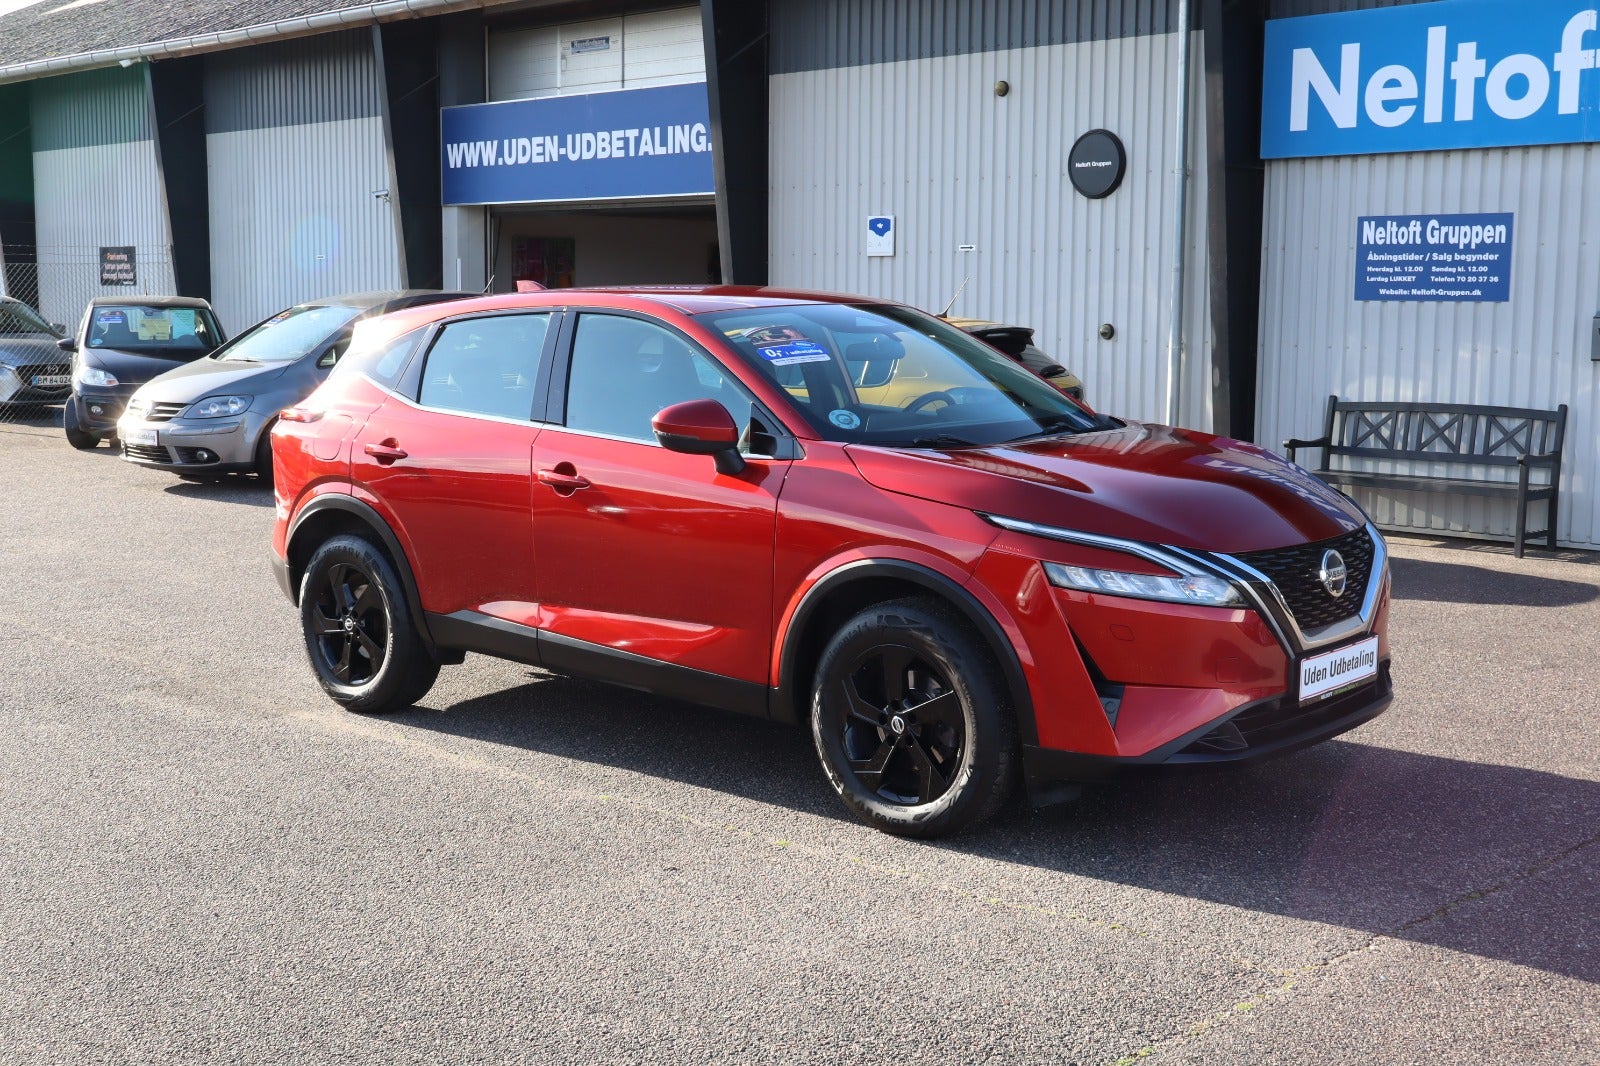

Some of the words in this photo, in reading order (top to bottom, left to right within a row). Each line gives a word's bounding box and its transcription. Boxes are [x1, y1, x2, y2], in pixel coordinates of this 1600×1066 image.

[1289, 9, 1600, 132] Neltof
[447, 122, 713, 169] WWW.UDEN-UDBETALING.
[1362, 219, 1422, 245] Neltoft
[1426, 218, 1507, 249] Gruppen
[1367, 250, 1424, 262] Åbningstider
[1432, 252, 1452, 262] Salg
[1454, 252, 1499, 262] begynder
[1379, 288, 1410, 296] Website:
[1411, 288, 1482, 297] Neltoft-Gruppen.dk
[1304, 668, 1327, 686] Uden
[1330, 651, 1374, 677] Udbetaling
